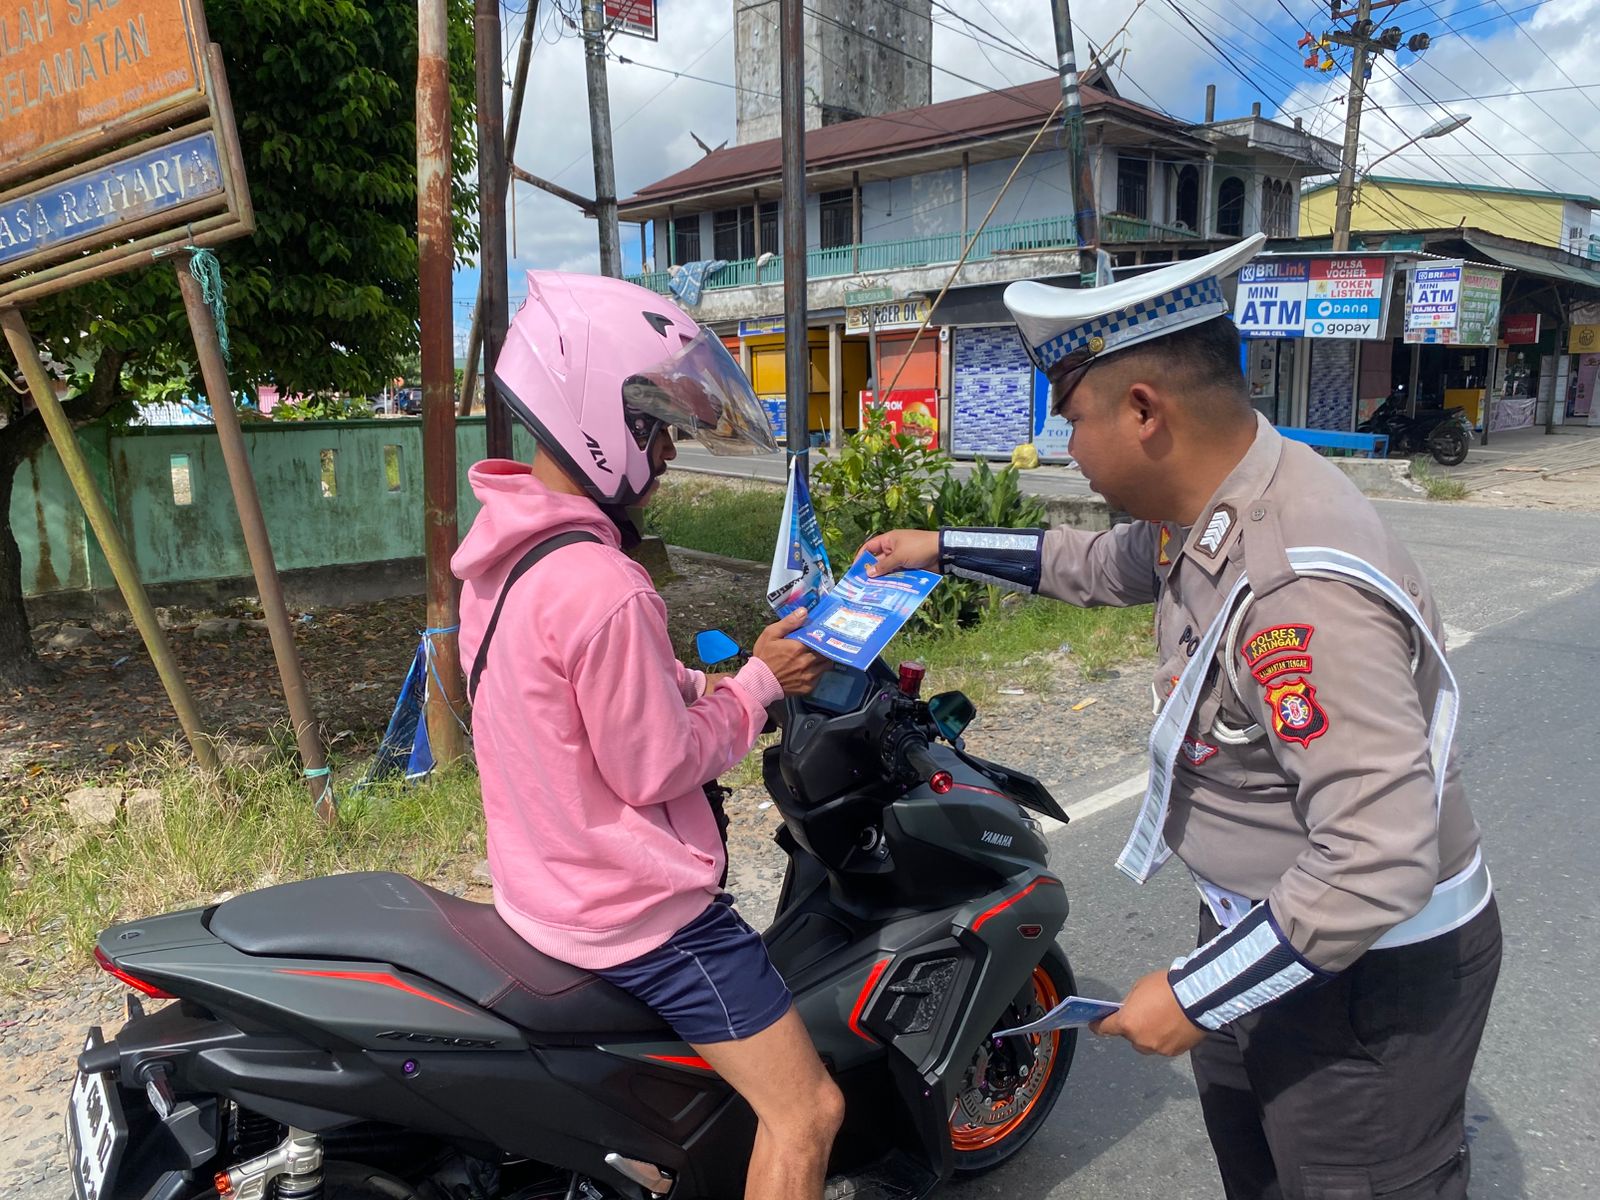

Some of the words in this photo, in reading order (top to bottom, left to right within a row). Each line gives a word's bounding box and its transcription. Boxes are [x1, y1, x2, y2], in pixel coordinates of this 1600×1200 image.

[0, 0, 54, 55] LAH
[58, 150, 209, 229] RAHARJA
[1255, 263, 1306, 277] BRILink
[1330, 260, 1363, 270] PULSA
[1326, 269, 1367, 279] VOCHER
[1335, 280, 1373, 289] TOKEN
[1247, 286, 1279, 299] MINI
[1330, 289, 1375, 298] LISTRIK
[1418, 289, 1454, 303] ATM
[861, 304, 900, 326] BRGER
[903, 303, 918, 321] OK
[1240, 300, 1302, 325] ATM
[1333, 304, 1369, 314] DANA
[1326, 323, 1371, 335] gopay
[1250, 628, 1296, 649] POLRES
[1251, 637, 1300, 659] KATINGAN
[981, 830, 1013, 848] YAMAHA
